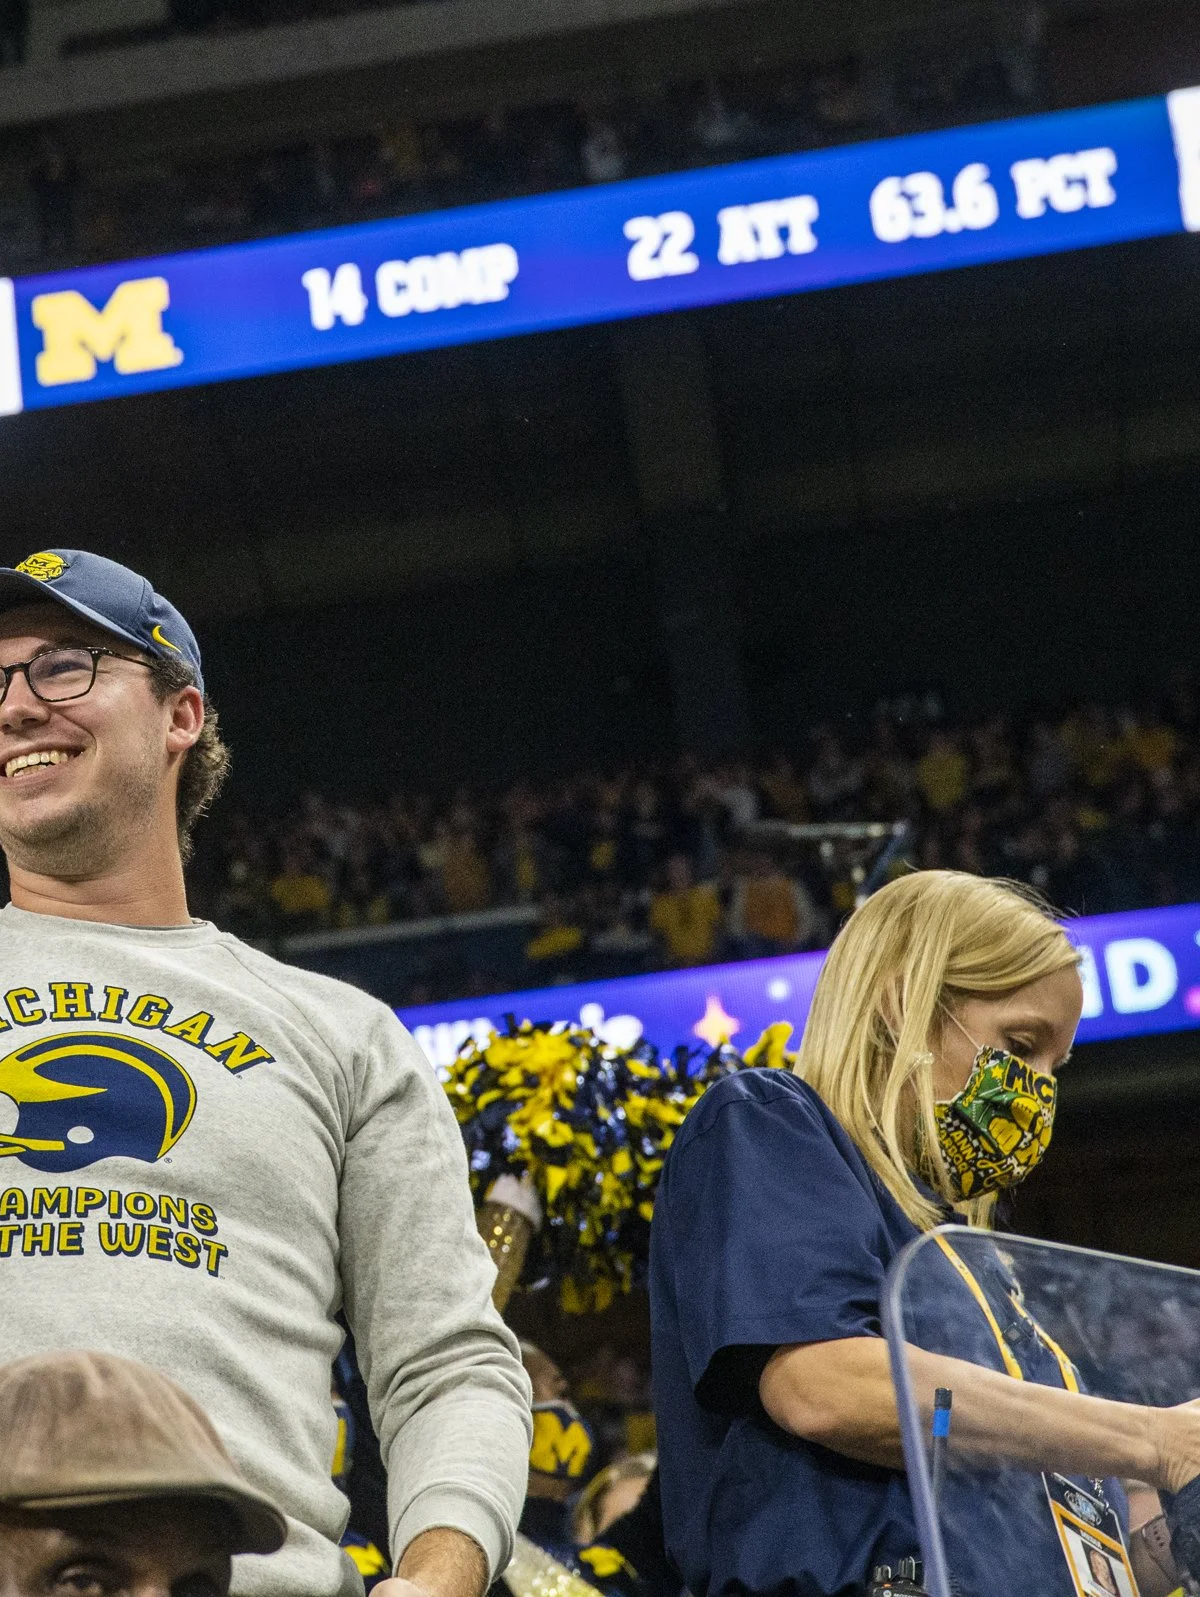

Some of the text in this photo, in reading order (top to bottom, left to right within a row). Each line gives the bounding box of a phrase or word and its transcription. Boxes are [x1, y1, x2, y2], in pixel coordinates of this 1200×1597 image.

[869, 147, 1118, 242] 63.6 PCT
[623, 195, 818, 281] 22 ATT
[302, 243, 519, 330] 14 COMP
[32, 277, 183, 387] M
[950, 1130, 976, 1161] ANN
[99, 1222, 229, 1278] WEST
[530, 1411, 592, 1477] M
